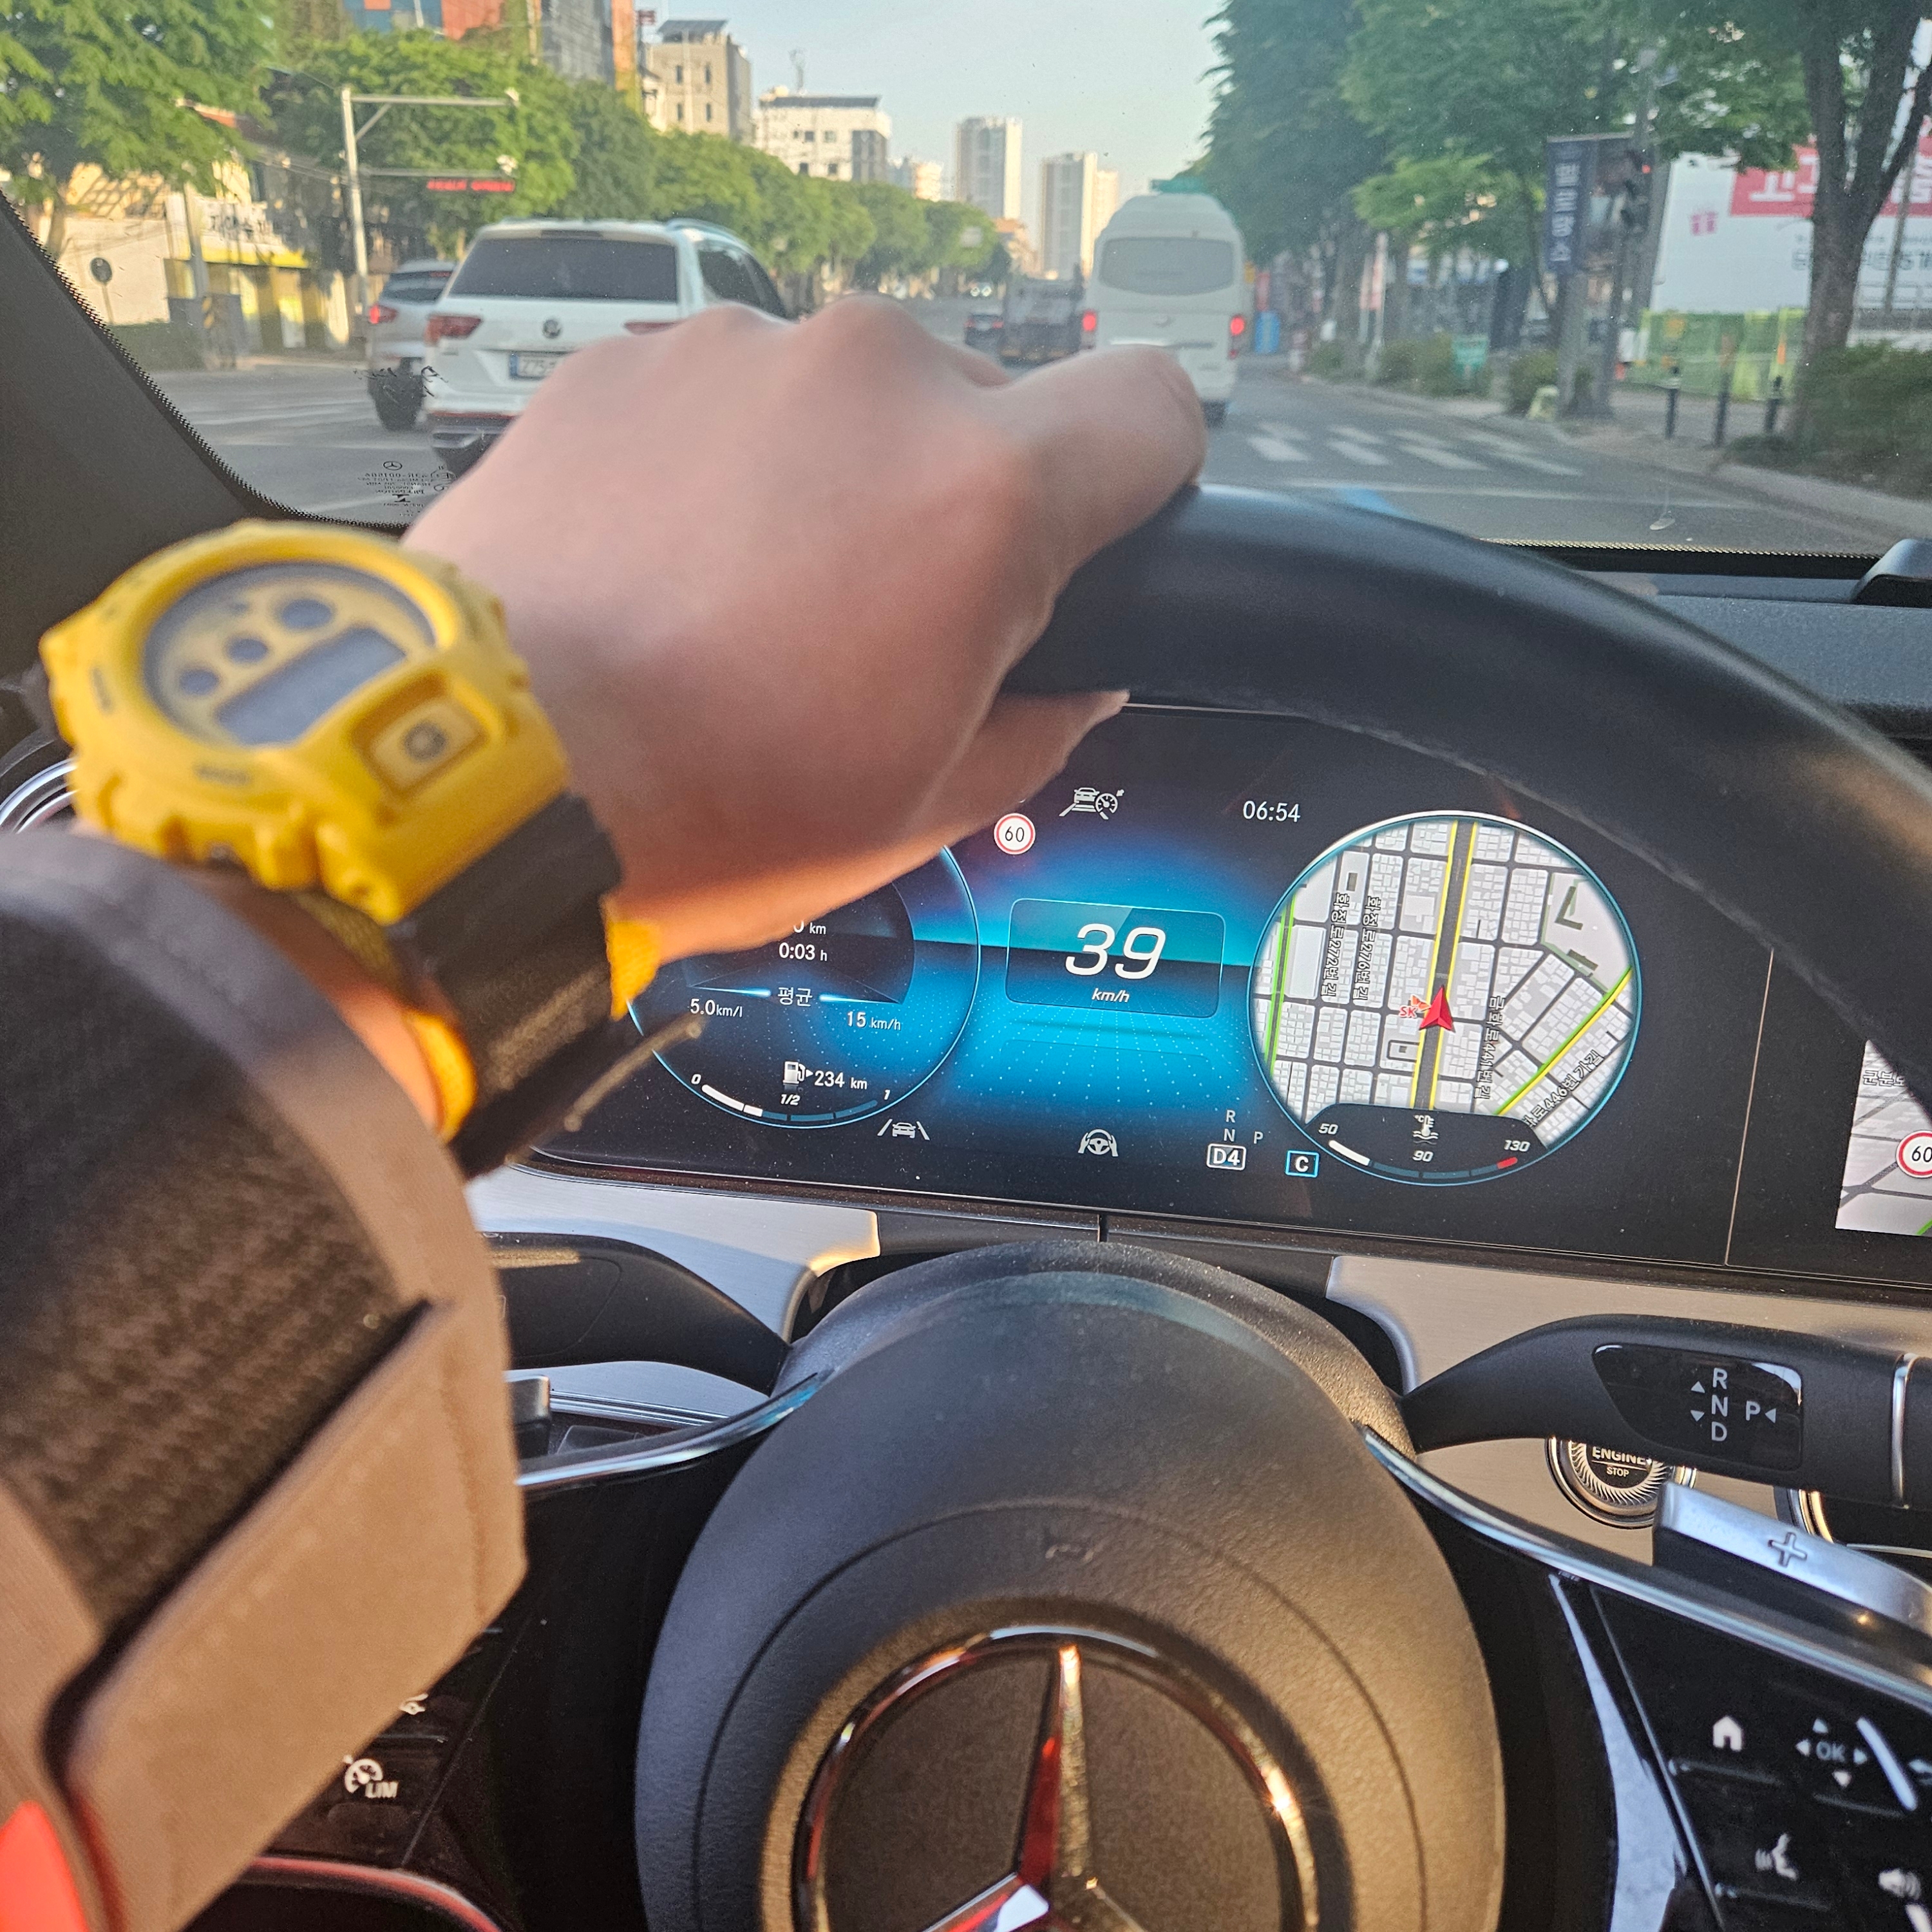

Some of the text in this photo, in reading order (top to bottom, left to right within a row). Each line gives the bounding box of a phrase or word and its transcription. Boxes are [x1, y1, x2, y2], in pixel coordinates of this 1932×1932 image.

[1243, 800, 1301, 822] 06:54
[1005, 826, 1025, 842] 60
[809, 922, 826, 934] km
[779, 942, 828, 961] 0:03 h
[1065, 923, 1166, 980] 39
[777, 987, 813, 1007] 평균
[1091, 987, 1130, 1003] km/h
[1400, 1006, 1416, 1017] SK
[847, 1011, 902, 1030] 15 km/h
[691, 1074, 701, 1084] 0
[814, 1070, 867, 1090] 234 km
[781, 1094, 800, 1105] 1/2
[884, 1090, 890, 1100] 1
[1226, 1110, 1236, 1123] R
[1224, 1128, 1235, 1142] N
[1318, 1123, 1338, 1135] 50
[1254, 1132, 1264, 1144] P
[1504, 1139, 1531, 1152] 130
[1213, 1148, 1240, 1166] D4
[1412, 1150, 1434, 1162] 90
[1911, 1146, 1932, 1162] 60
[1295, 1156, 1309, 1172] C
[1712, 1367, 1728, 1390] R
[1711, 1394, 1728, 1417] N
[1745, 1400, 1761, 1421] P
[1711, 1421, 1727, 1442] D
[1592, 1446, 1647, 1465] ENGINE
[1606, 1466, 1629, 1477] STOP
[1816, 1740, 1846, 1763] OK
[365, 1781, 399, 1799] LIM
